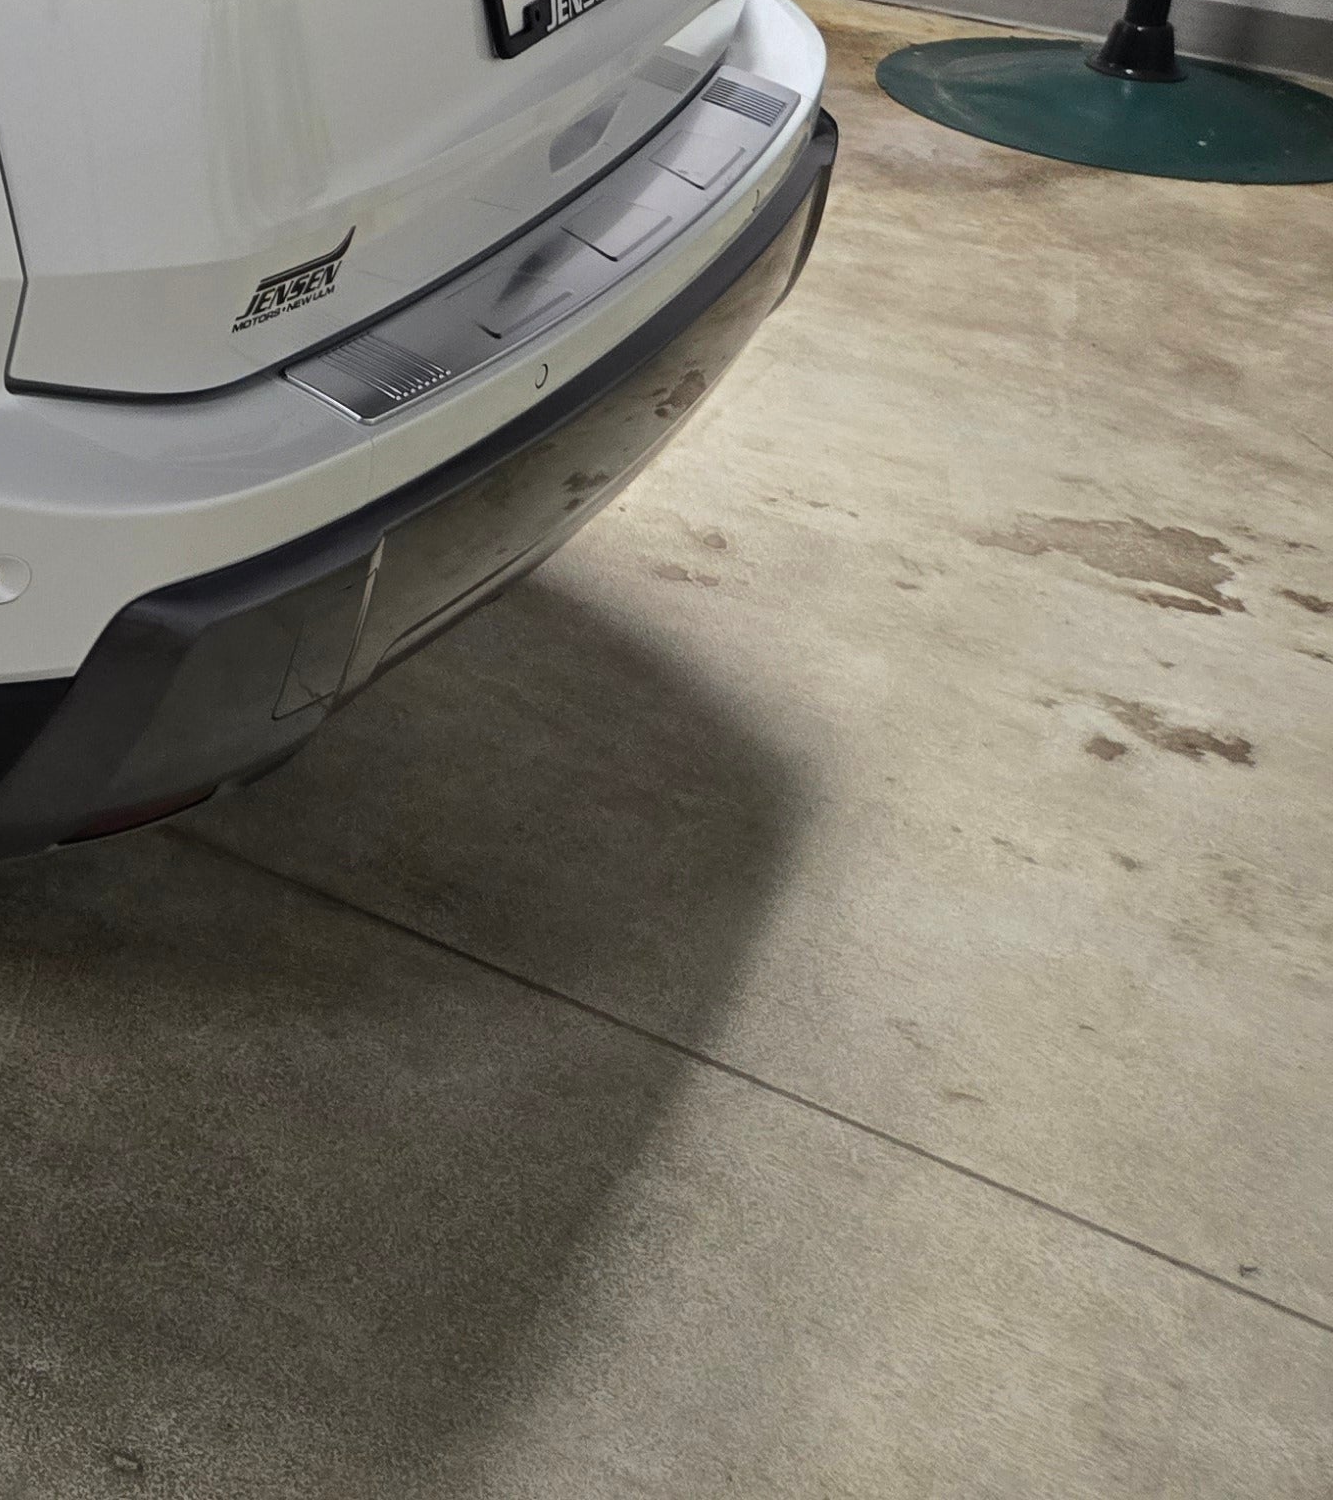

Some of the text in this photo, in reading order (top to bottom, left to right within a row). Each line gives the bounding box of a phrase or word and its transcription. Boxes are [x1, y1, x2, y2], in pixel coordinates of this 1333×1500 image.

[232, 284, 335, 333] MOTORS NEW ULM
[236, 260, 342, 321] JENSEN
